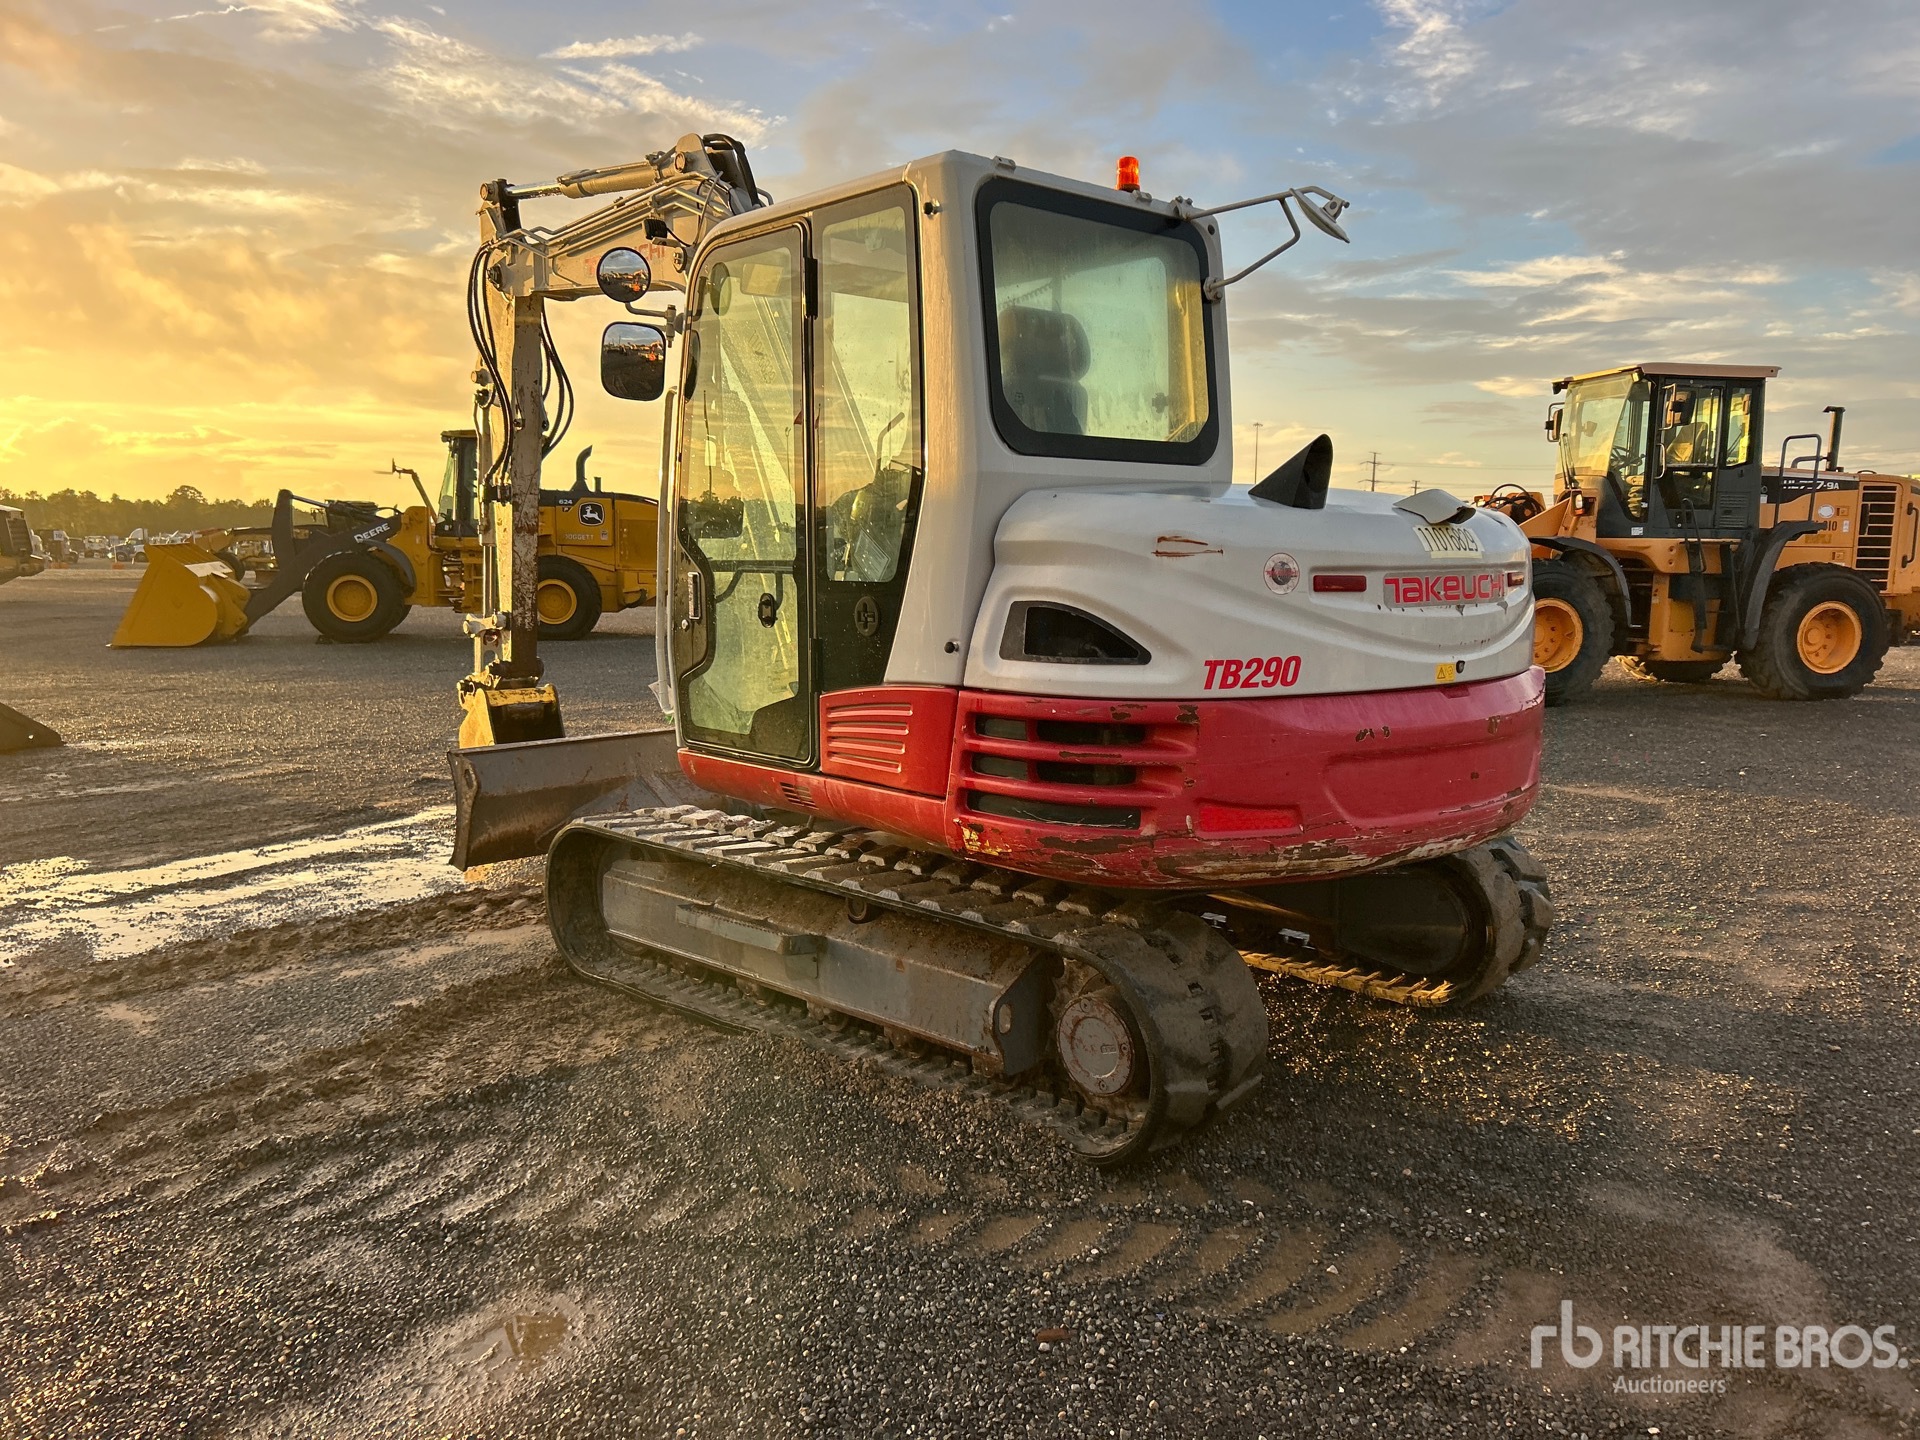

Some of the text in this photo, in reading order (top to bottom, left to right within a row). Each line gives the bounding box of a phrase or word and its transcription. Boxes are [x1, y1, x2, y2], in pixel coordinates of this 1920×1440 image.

[558, 499, 573, 507] 624
[354, 522, 391, 544] DEERE
[1417, 527, 1479, 552] 11016829
[1384, 574, 1505, 604] TAKEUCHI
[1203, 655, 1302, 690] TB290
